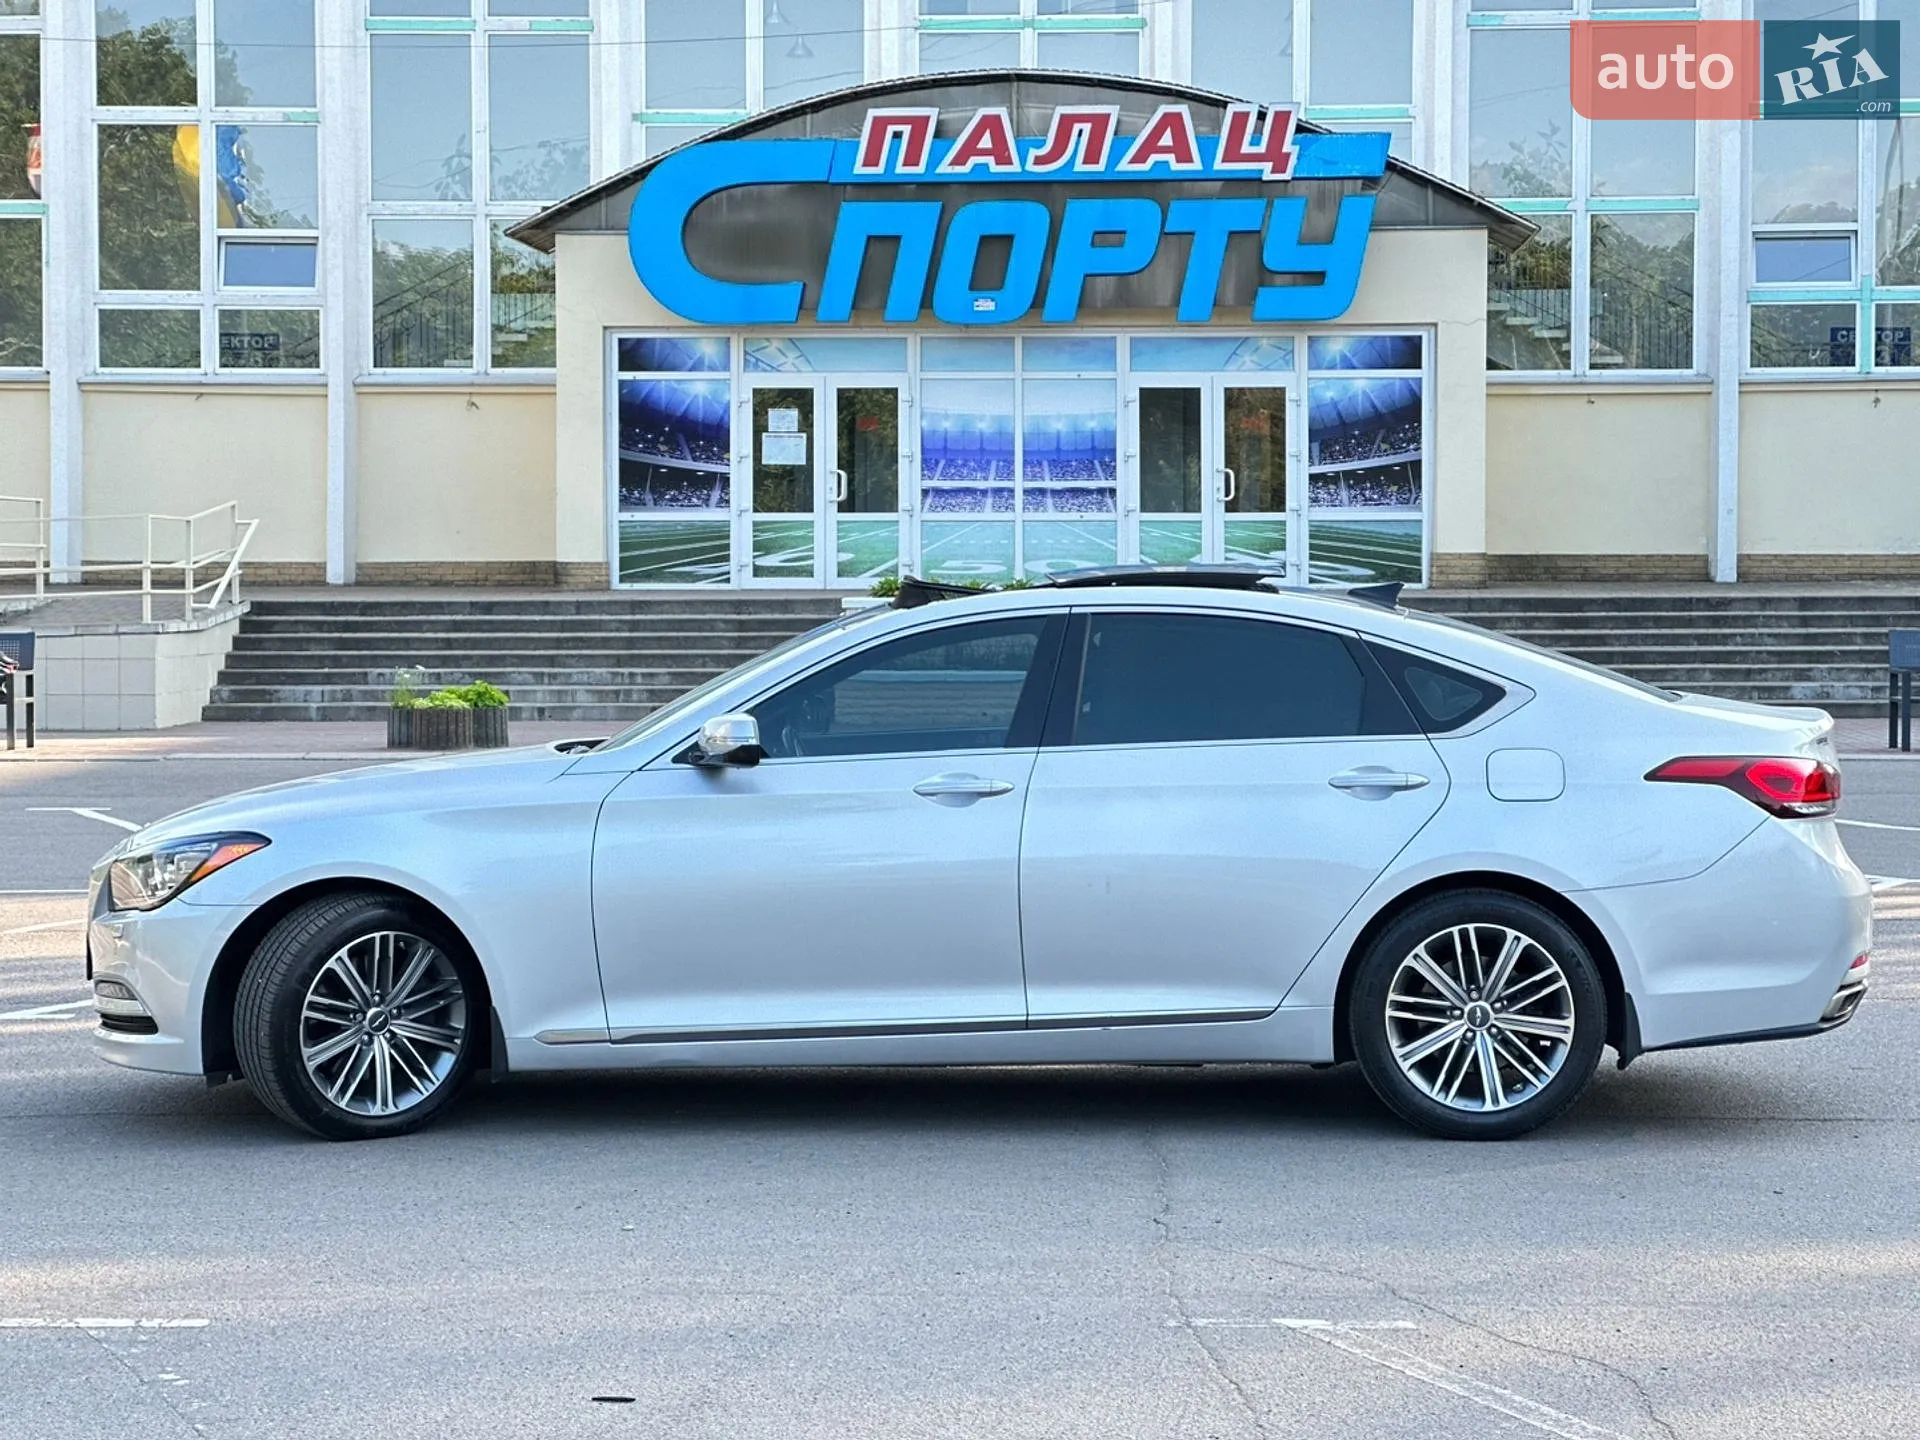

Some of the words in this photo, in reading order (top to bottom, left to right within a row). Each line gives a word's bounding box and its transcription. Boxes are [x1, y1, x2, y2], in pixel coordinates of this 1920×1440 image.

[854, 103, 1300, 181] ПАЛАЦ
[628, 133, 1392, 324] СПОРТУ
[220, 335, 275, 349] ЕКТОР
